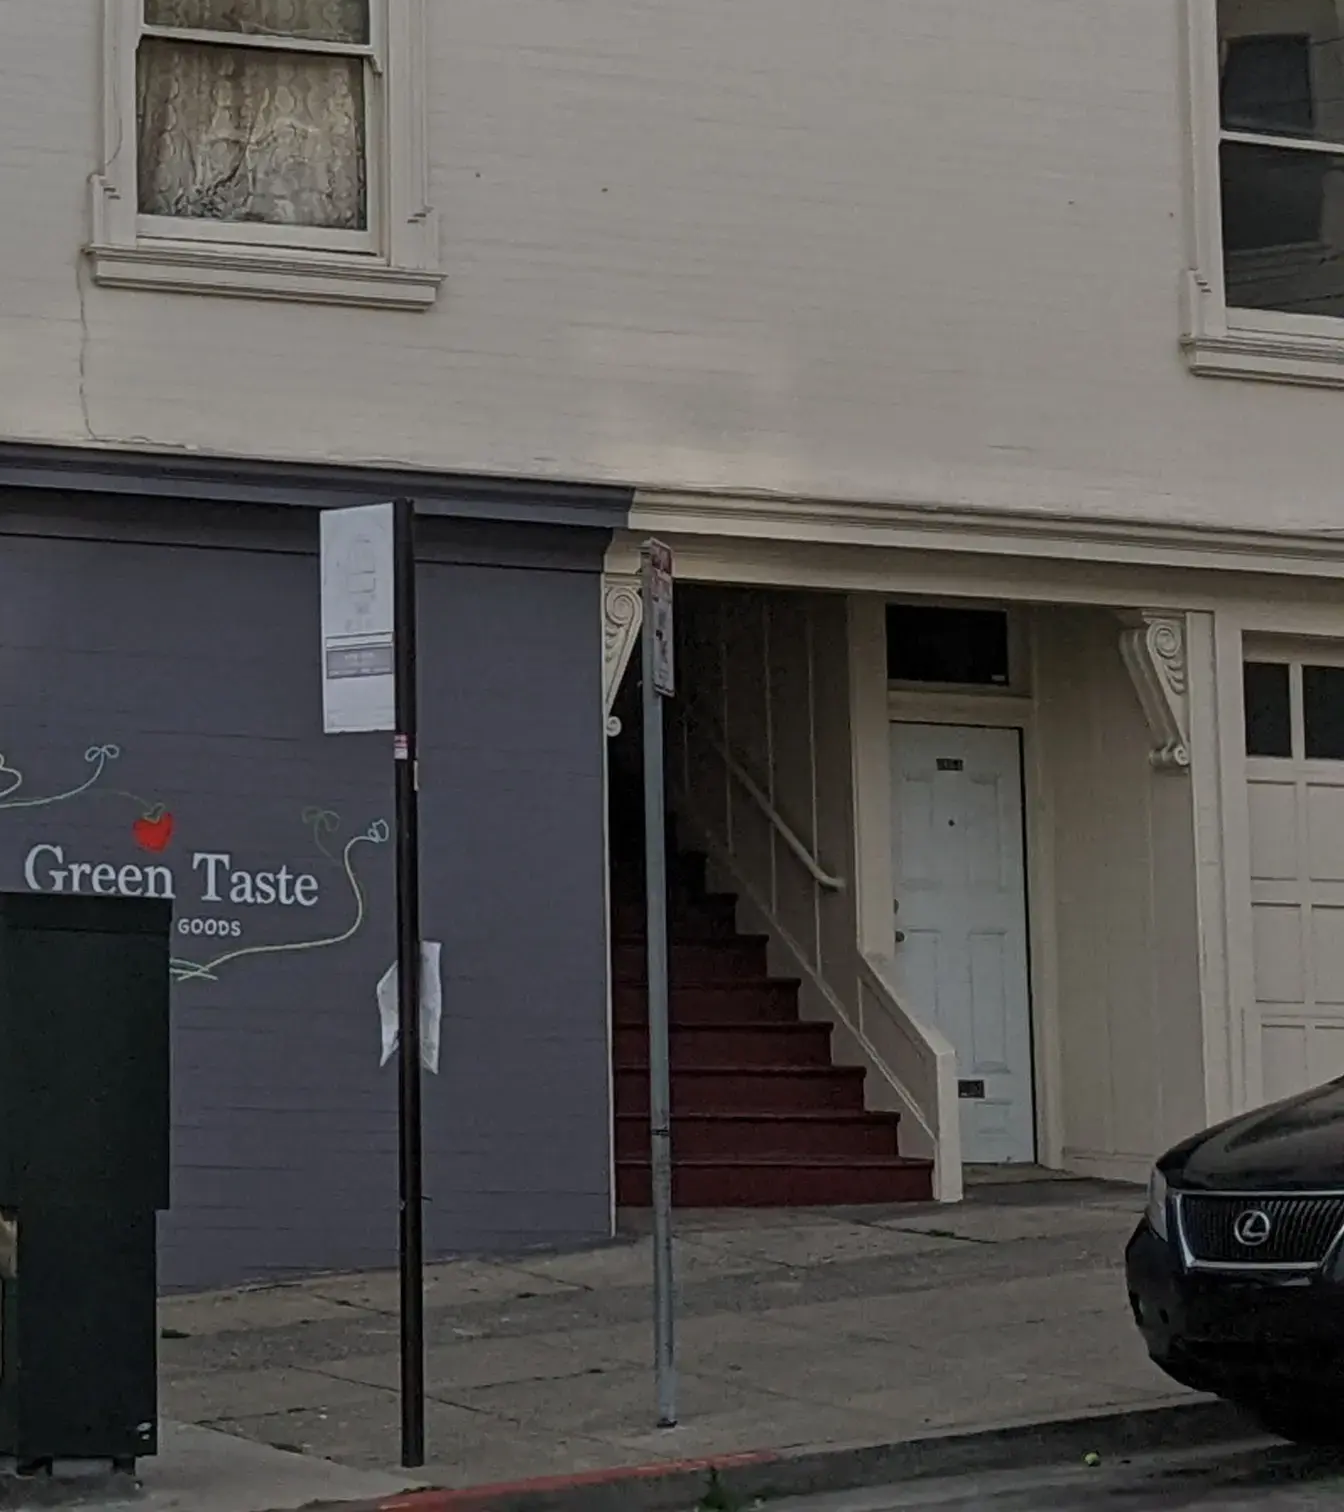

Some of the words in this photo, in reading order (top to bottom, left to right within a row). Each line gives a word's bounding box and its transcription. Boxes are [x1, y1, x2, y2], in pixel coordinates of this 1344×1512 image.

[24, 843, 177, 899] Green
[192, 852, 319, 906] Taste
[177, 918, 242, 937] GOODS
